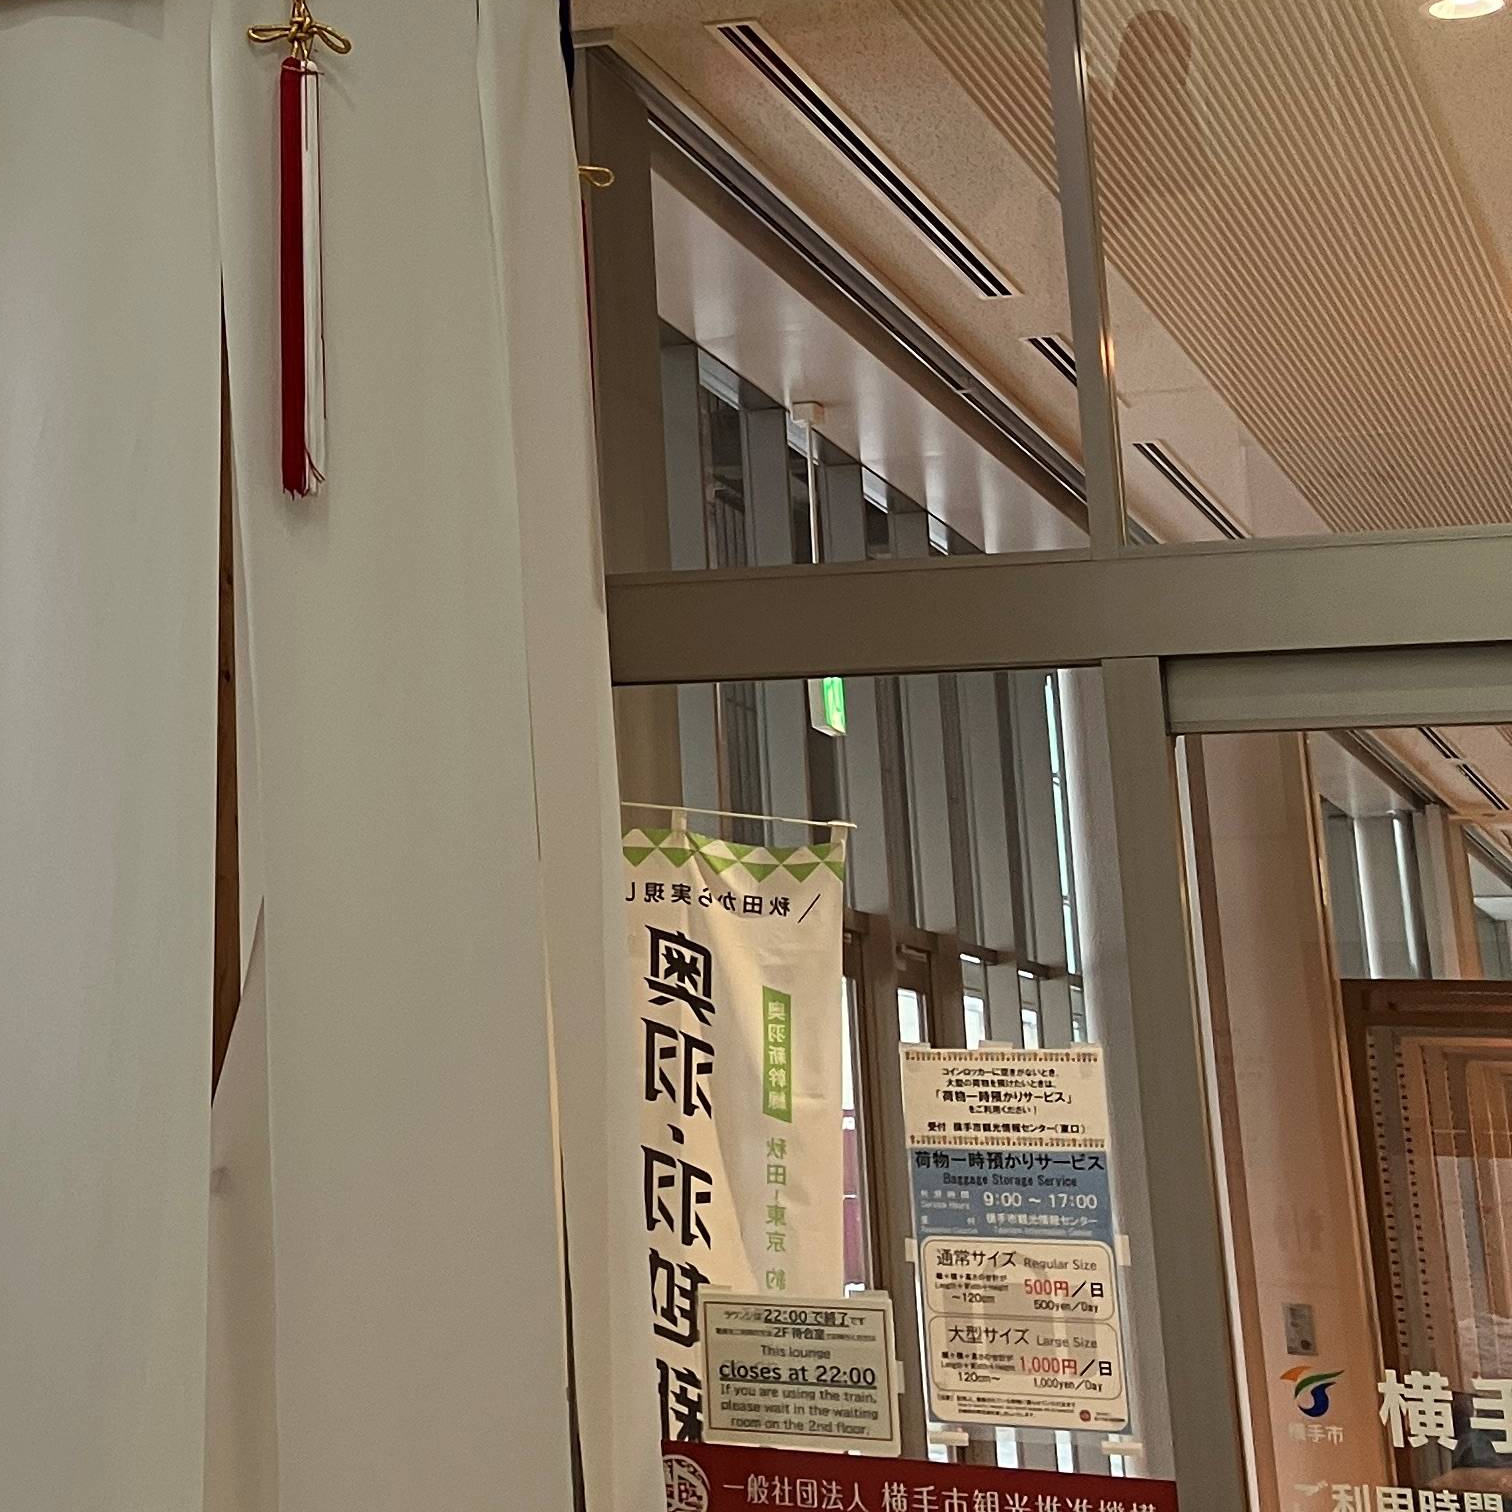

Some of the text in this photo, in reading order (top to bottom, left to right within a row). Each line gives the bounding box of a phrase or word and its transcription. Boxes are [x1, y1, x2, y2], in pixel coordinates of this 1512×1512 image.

[914, 1150, 1105, 1171] 荷物一時預かりサービス
[942, 1173, 1078, 1187] Baggage Storage Service
[1049, 1194, 1098, 1209] 17:00
[936, 1248, 1017, 1268] 通常サイズ
[1024, 1257, 1098, 1271] Regular Size
[948, 1325, 1030, 1346] 大型サイズ
[1036, 1334, 1098, 1349] Large Size
[760, 1344, 831, 1360] This lounge
[719, 1360, 876, 1385] closes at 22:00
[720, 1384, 731, 1396] If
[735, 1386, 757, 1398] you
[759, 1387, 779, 1398] are
[783, 1387, 816, 1402] using
[819, 1388, 841, 1402] the
[720, 1399, 879, 1421] please wait in the waiting
[730, 1417, 762, 1429] room
[764, 1419, 780, 1430] on
[783, 1419, 804, 1432] the
[808, 1420, 833, 1433] 2nd
[722, 1473, 870, 1512] 一般社団法人
